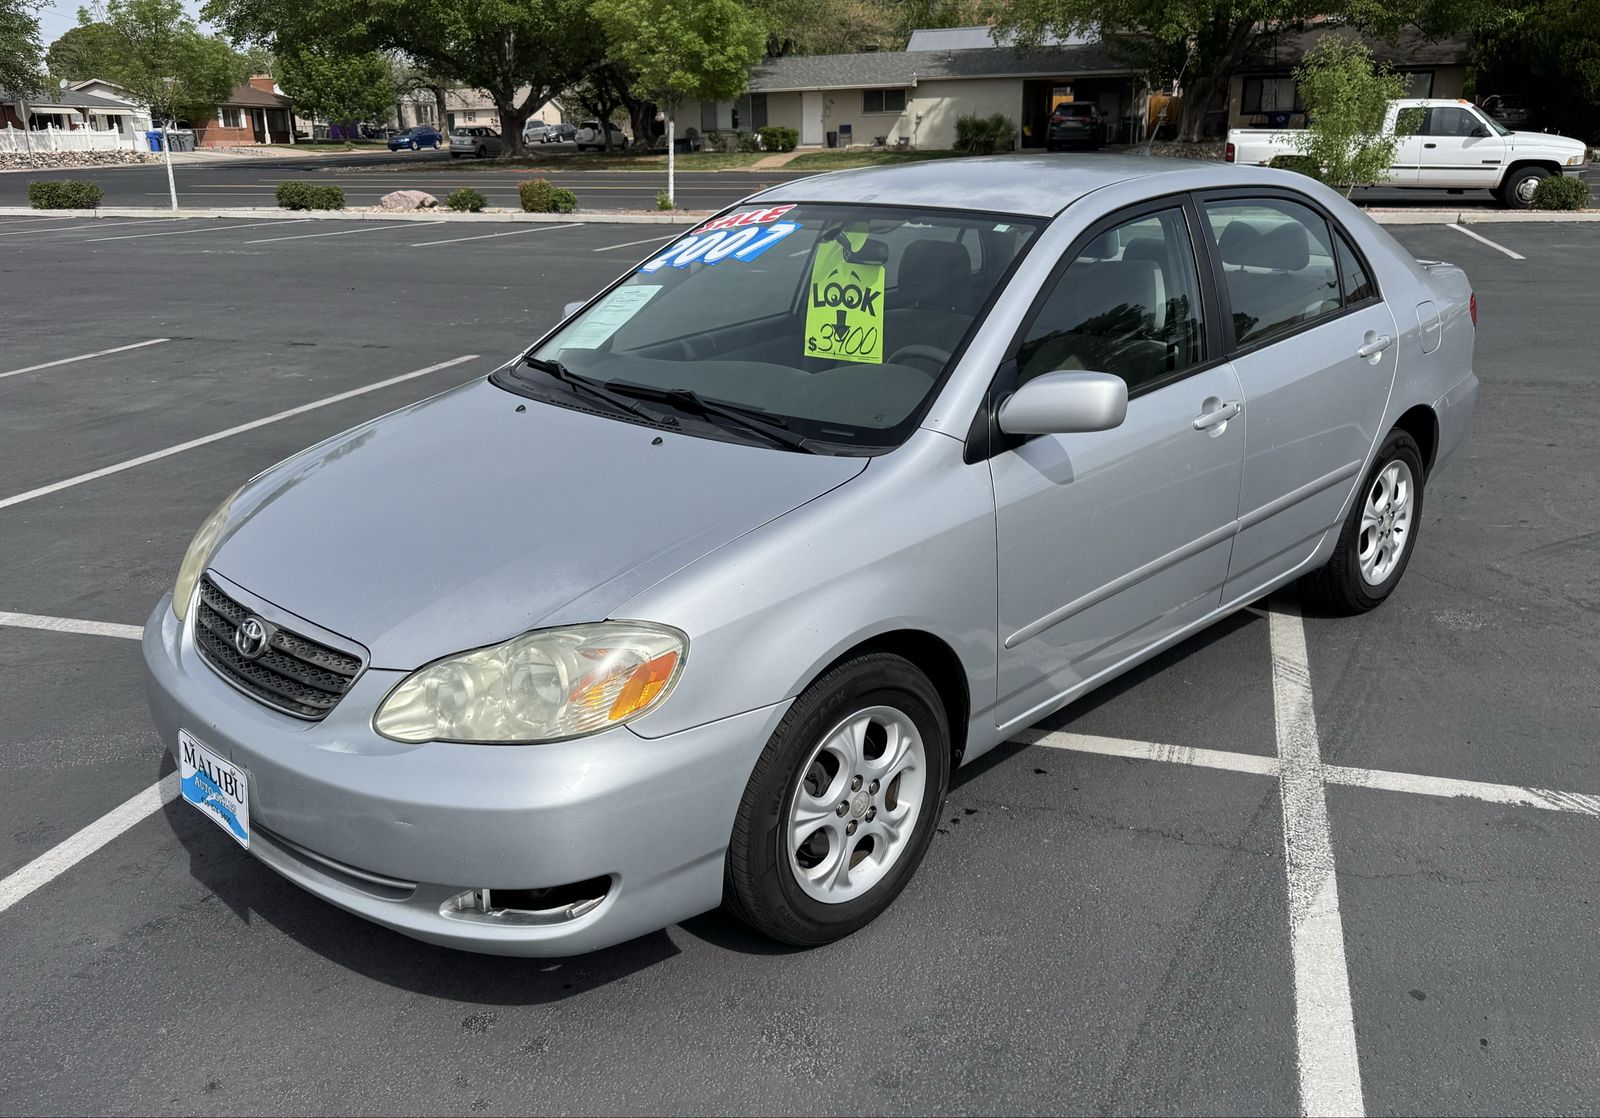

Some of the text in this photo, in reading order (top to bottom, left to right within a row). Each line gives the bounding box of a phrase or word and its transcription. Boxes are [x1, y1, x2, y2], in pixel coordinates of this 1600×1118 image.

[690, 204, 798, 236] SALE
[641, 223, 797, 273] 2007
[812, 282, 882, 317] LOOK
[183, 741, 244, 804] MALIBU
[194, 776, 215, 798] AUTO
